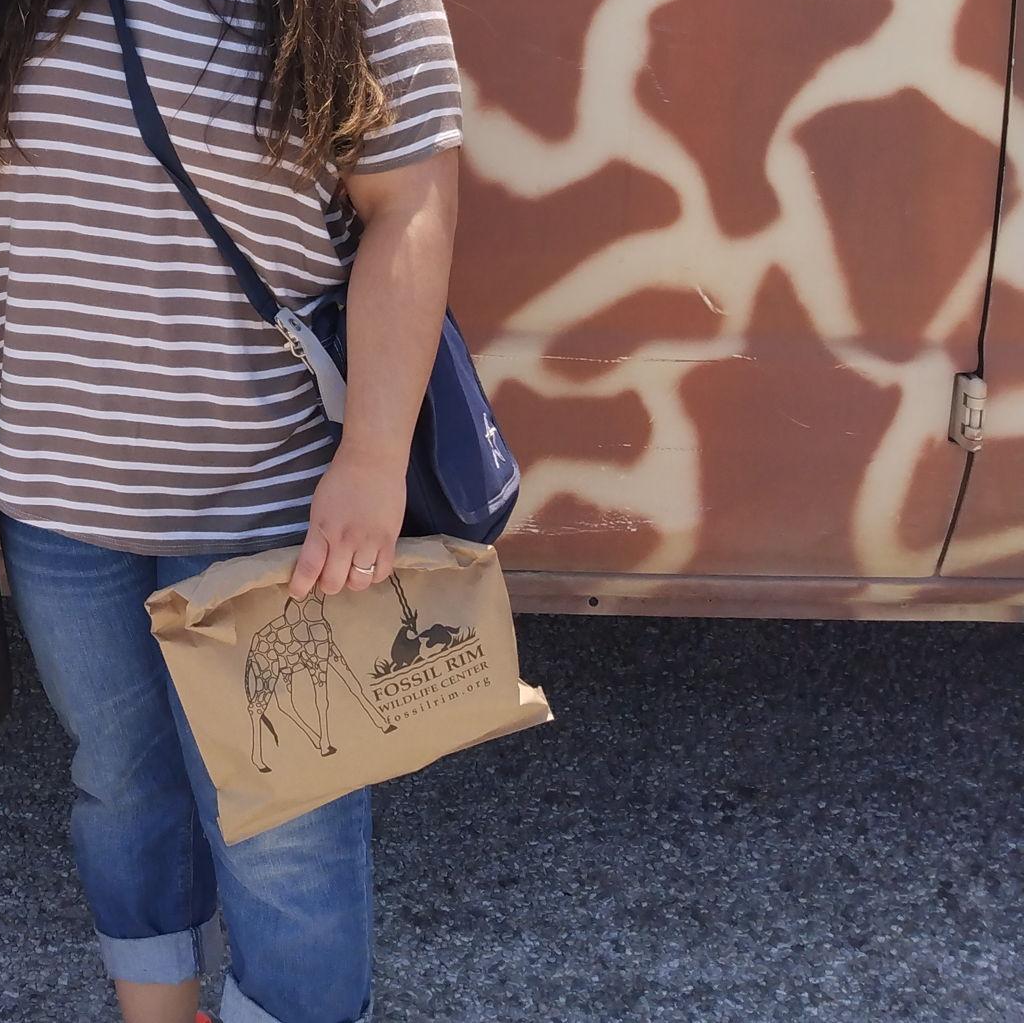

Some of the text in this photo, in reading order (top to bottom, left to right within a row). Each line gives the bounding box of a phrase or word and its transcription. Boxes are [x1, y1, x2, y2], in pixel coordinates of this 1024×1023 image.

[372, 644, 485, 702] FOSSIL RIM
[378, 661, 489, 714] WILDLIFE CENTER
[386, 677, 491, 724] fossilrim.org
